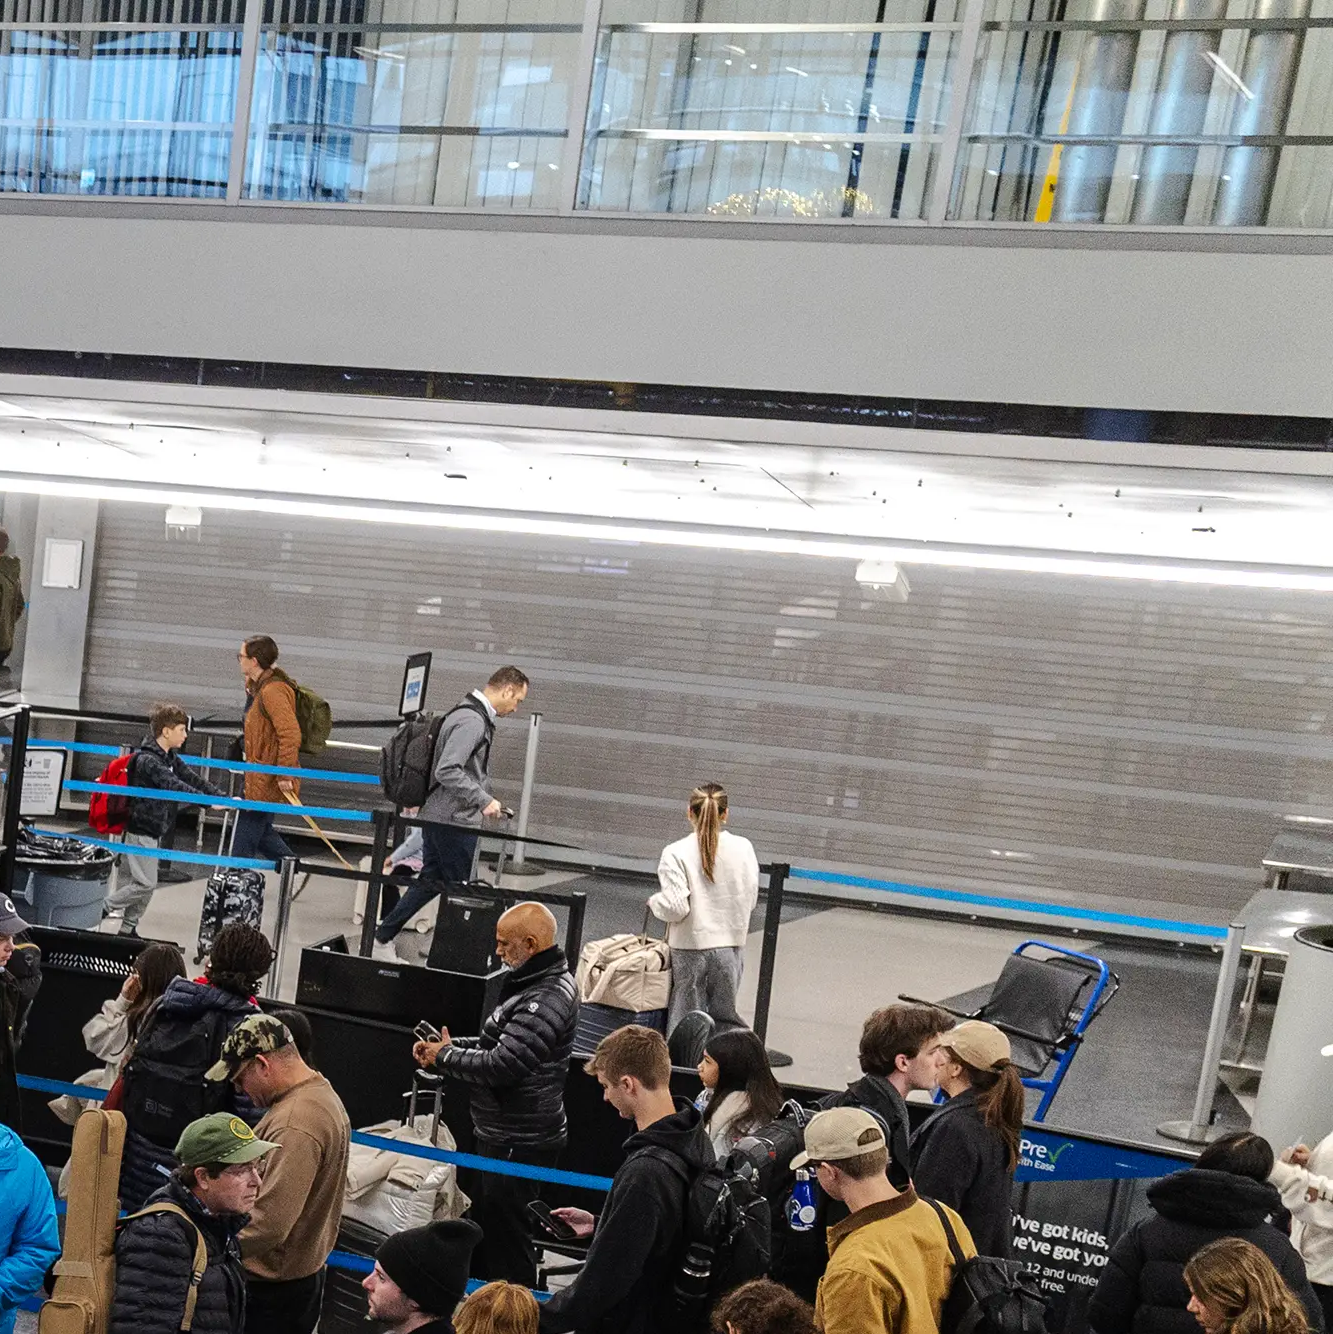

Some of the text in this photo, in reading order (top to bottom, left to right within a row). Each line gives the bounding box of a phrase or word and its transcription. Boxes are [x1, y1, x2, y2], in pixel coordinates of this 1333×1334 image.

[1034, 1160, 1055, 1172] Ease
[1041, 1222, 1069, 1239] got
[1071, 1227, 1109, 1250] kids,
[1053, 1245, 1080, 1262] got
[1026, 1262, 1041, 1274] 12
[1043, 1267, 1064, 1280] and
[1041, 1278, 1066, 1294] free.
